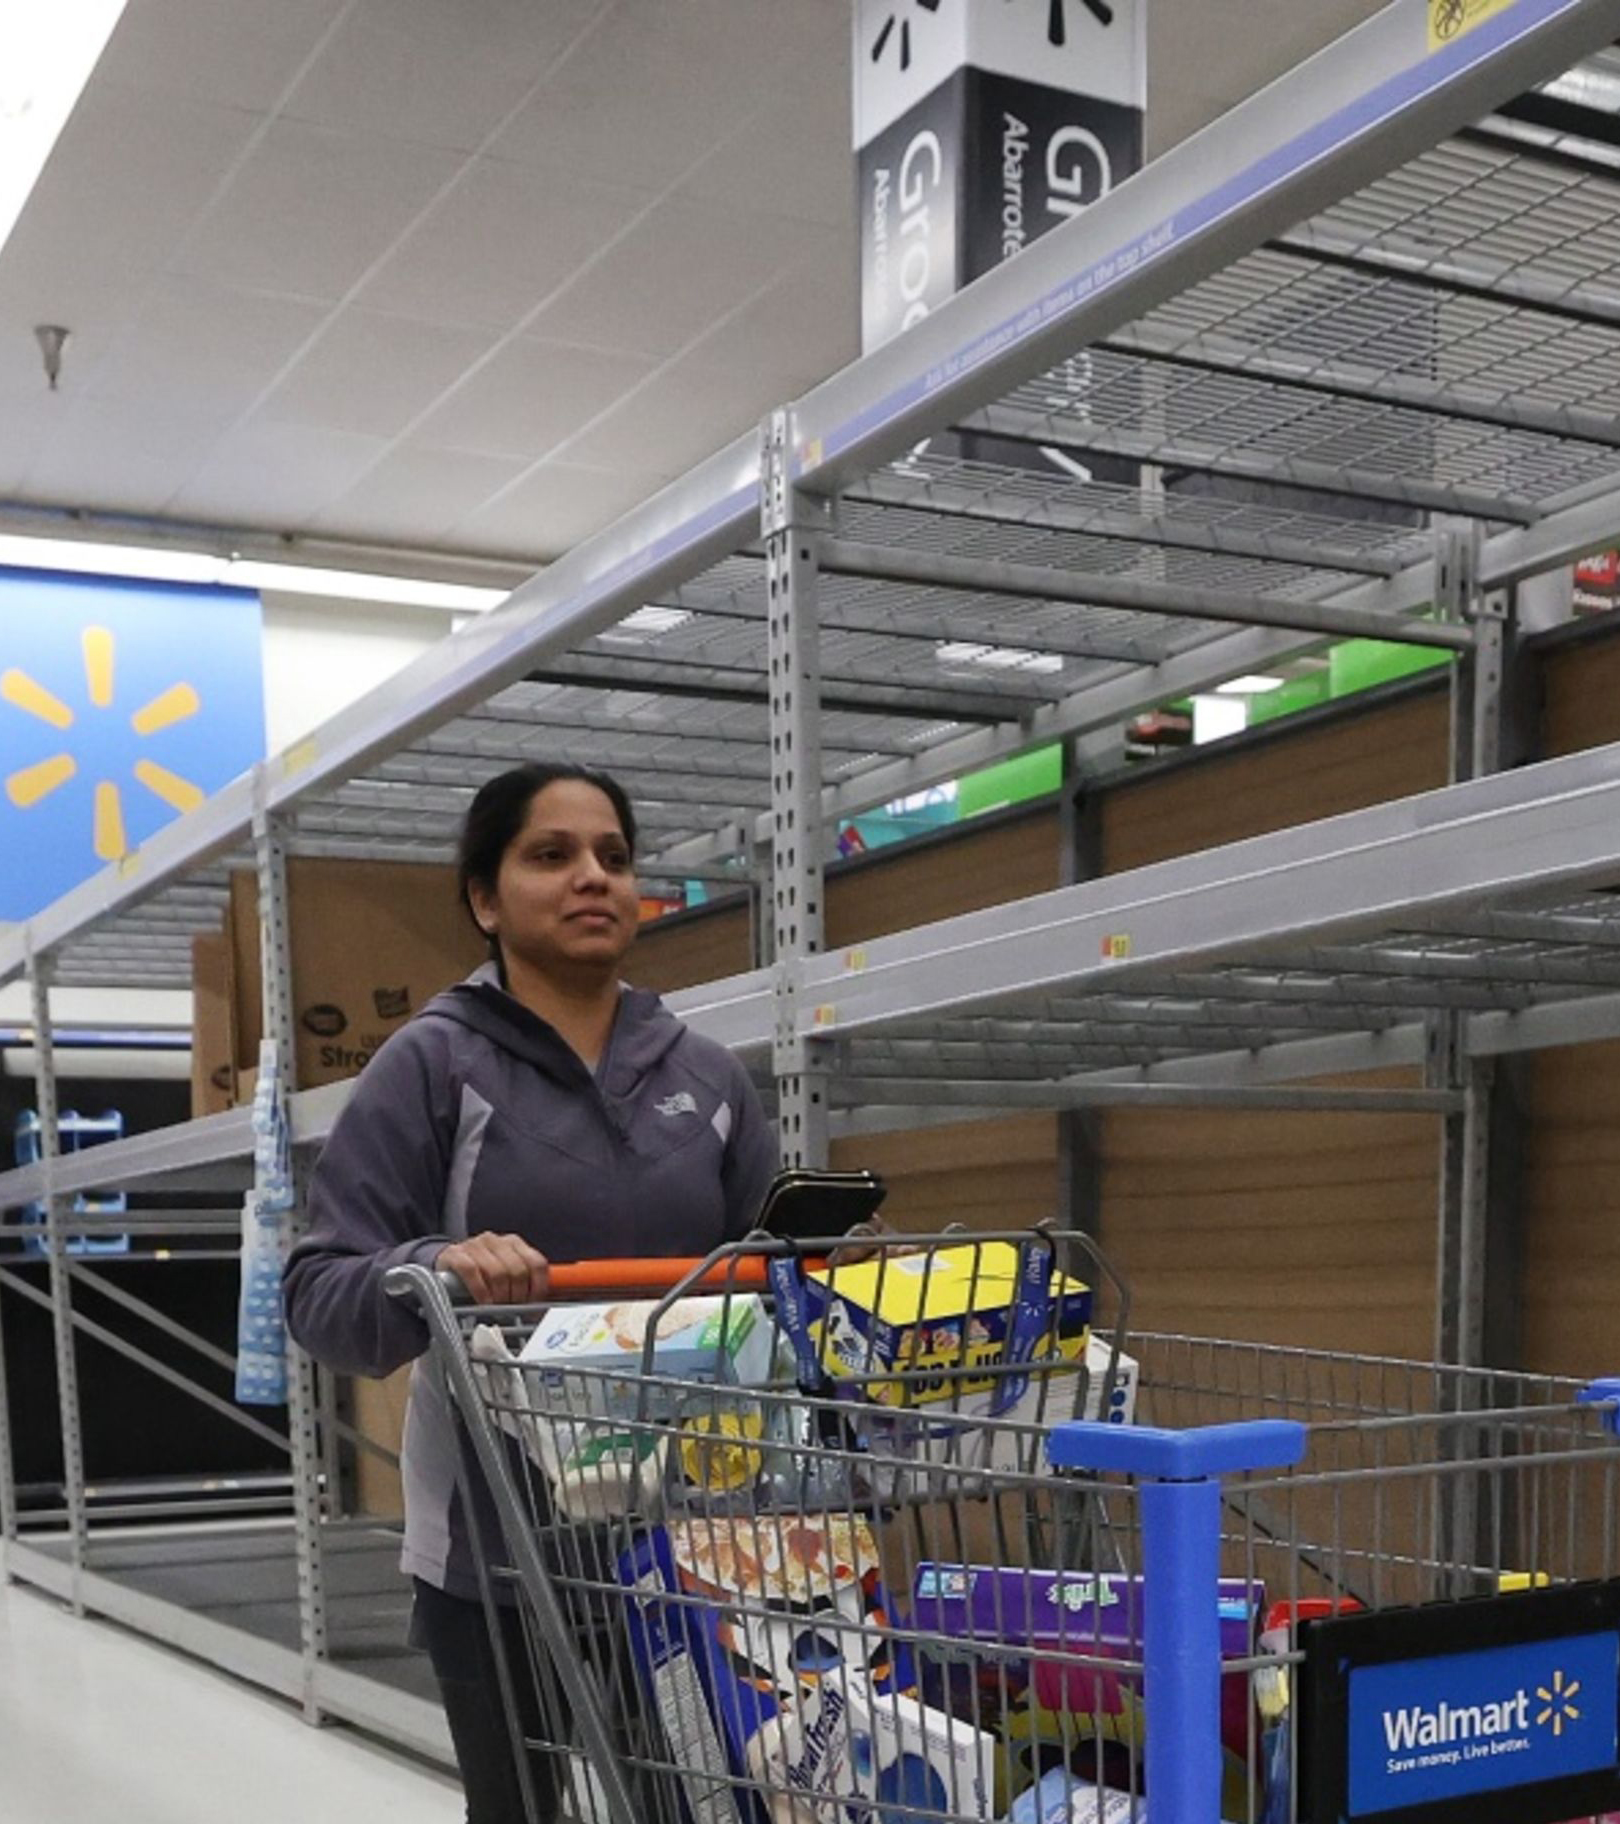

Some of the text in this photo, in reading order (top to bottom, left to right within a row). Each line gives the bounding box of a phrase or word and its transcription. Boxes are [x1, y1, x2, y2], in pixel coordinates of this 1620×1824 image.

[1383, 1689, 1529, 1752] Walmart
[1386, 1737, 1530, 1774] Save money. Live better.
